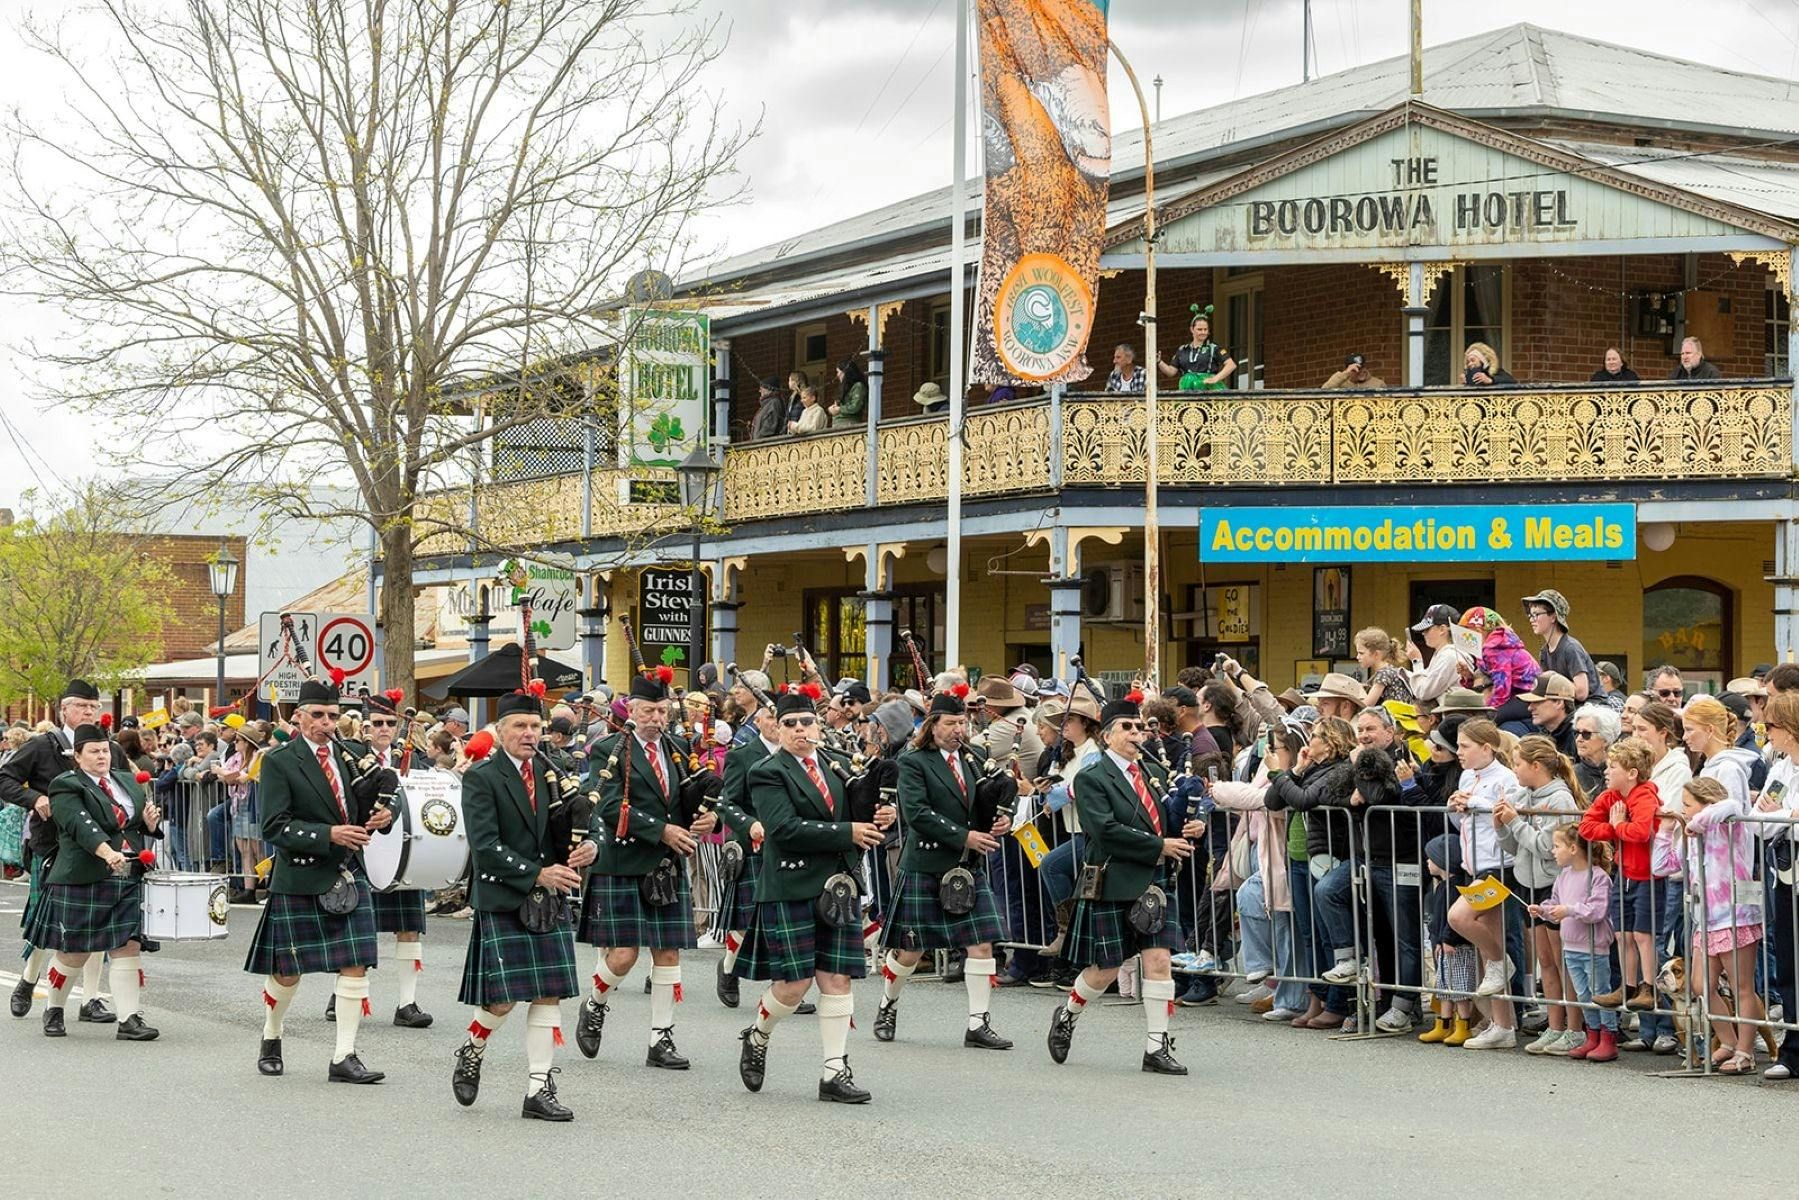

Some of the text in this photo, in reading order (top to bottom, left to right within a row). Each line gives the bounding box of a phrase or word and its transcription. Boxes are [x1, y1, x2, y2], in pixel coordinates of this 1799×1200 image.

[1391, 158, 1438, 185] THE
[1250, 190, 1578, 236] BOOROWA HOTEL
[1211, 516, 1624, 551] Accommodation & Meals
[526, 586, 575, 621] Cafe
[1225, 588, 1239, 603] GO
[658, 611, 688, 622] with
[643, 627, 691, 642] GUINNE
[325, 633, 367, 661] 40
[265, 680, 303, 689] PDESTRI
[278, 672, 298, 680] HIGH
